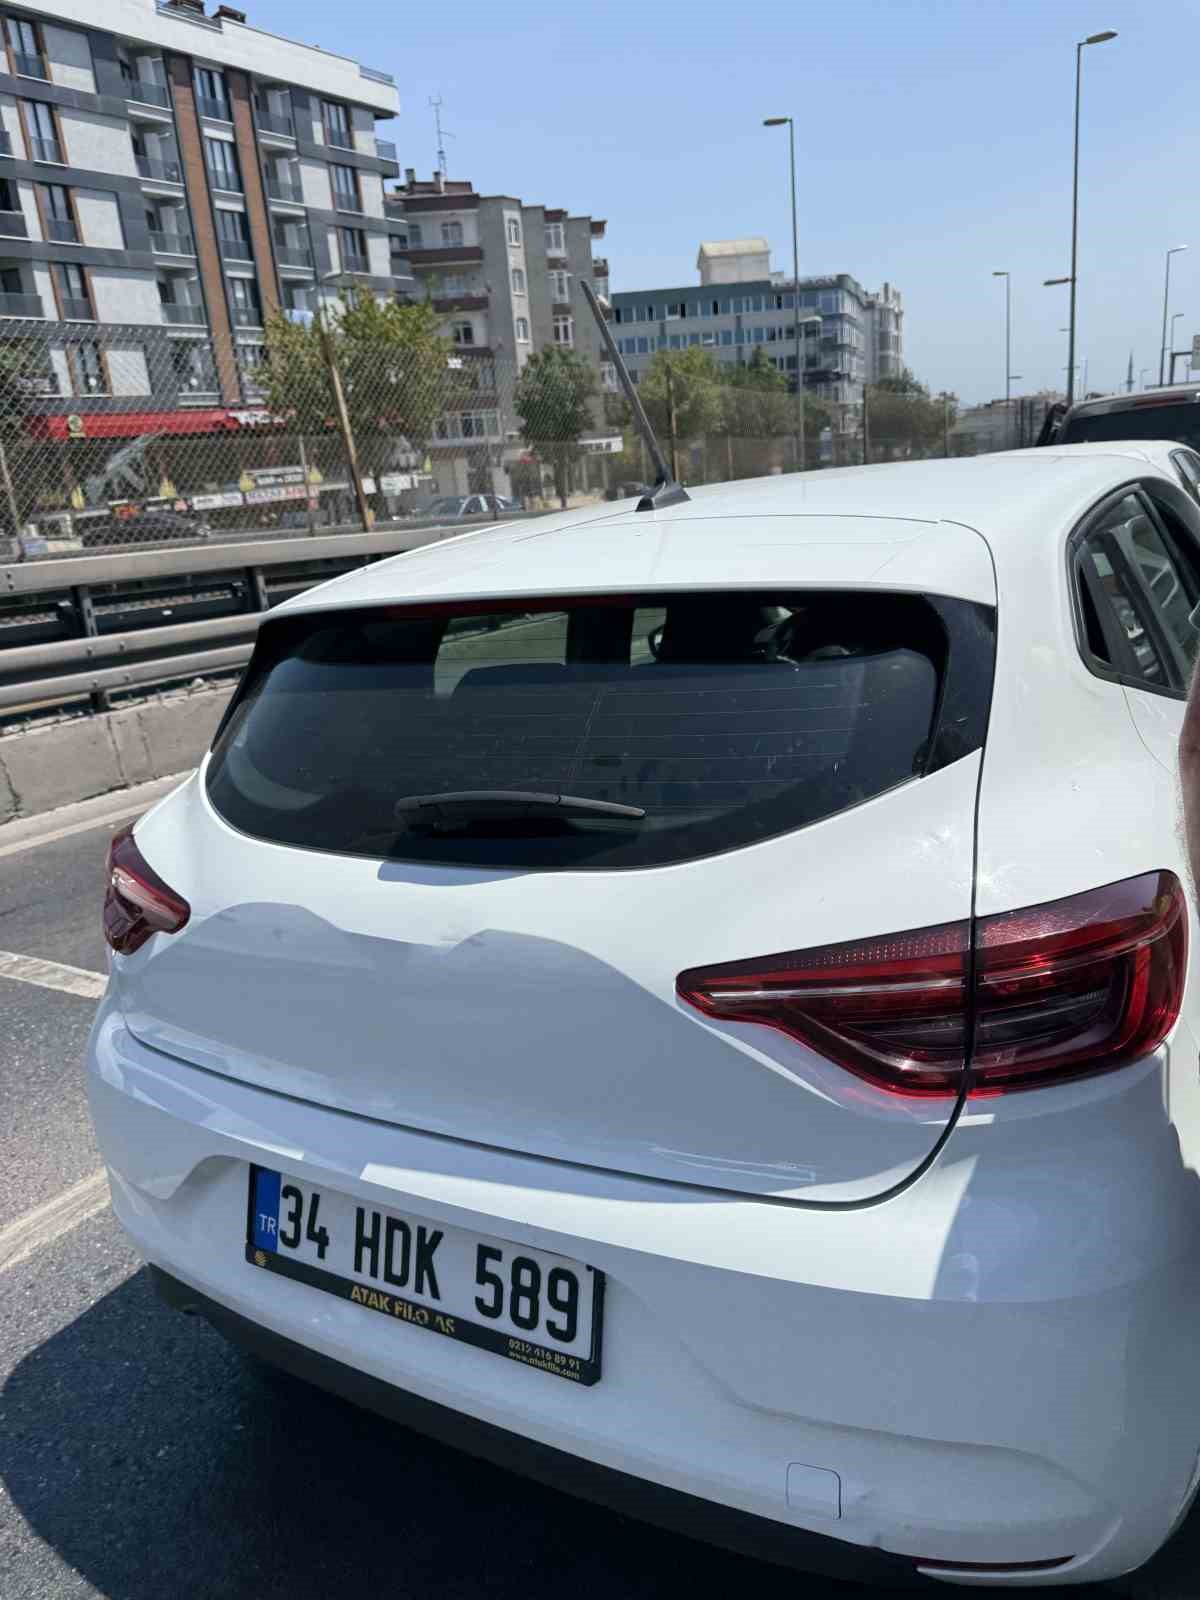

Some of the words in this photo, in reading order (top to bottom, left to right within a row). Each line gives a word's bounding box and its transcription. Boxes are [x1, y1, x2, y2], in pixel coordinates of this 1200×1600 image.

[258, 1213, 277, 1235] TR
[279, 1184, 329, 1260] 34
[354, 1206, 444, 1301] HDK
[475, 1243, 580, 1343] 589
[351, 1285, 391, 1312] ATAK
